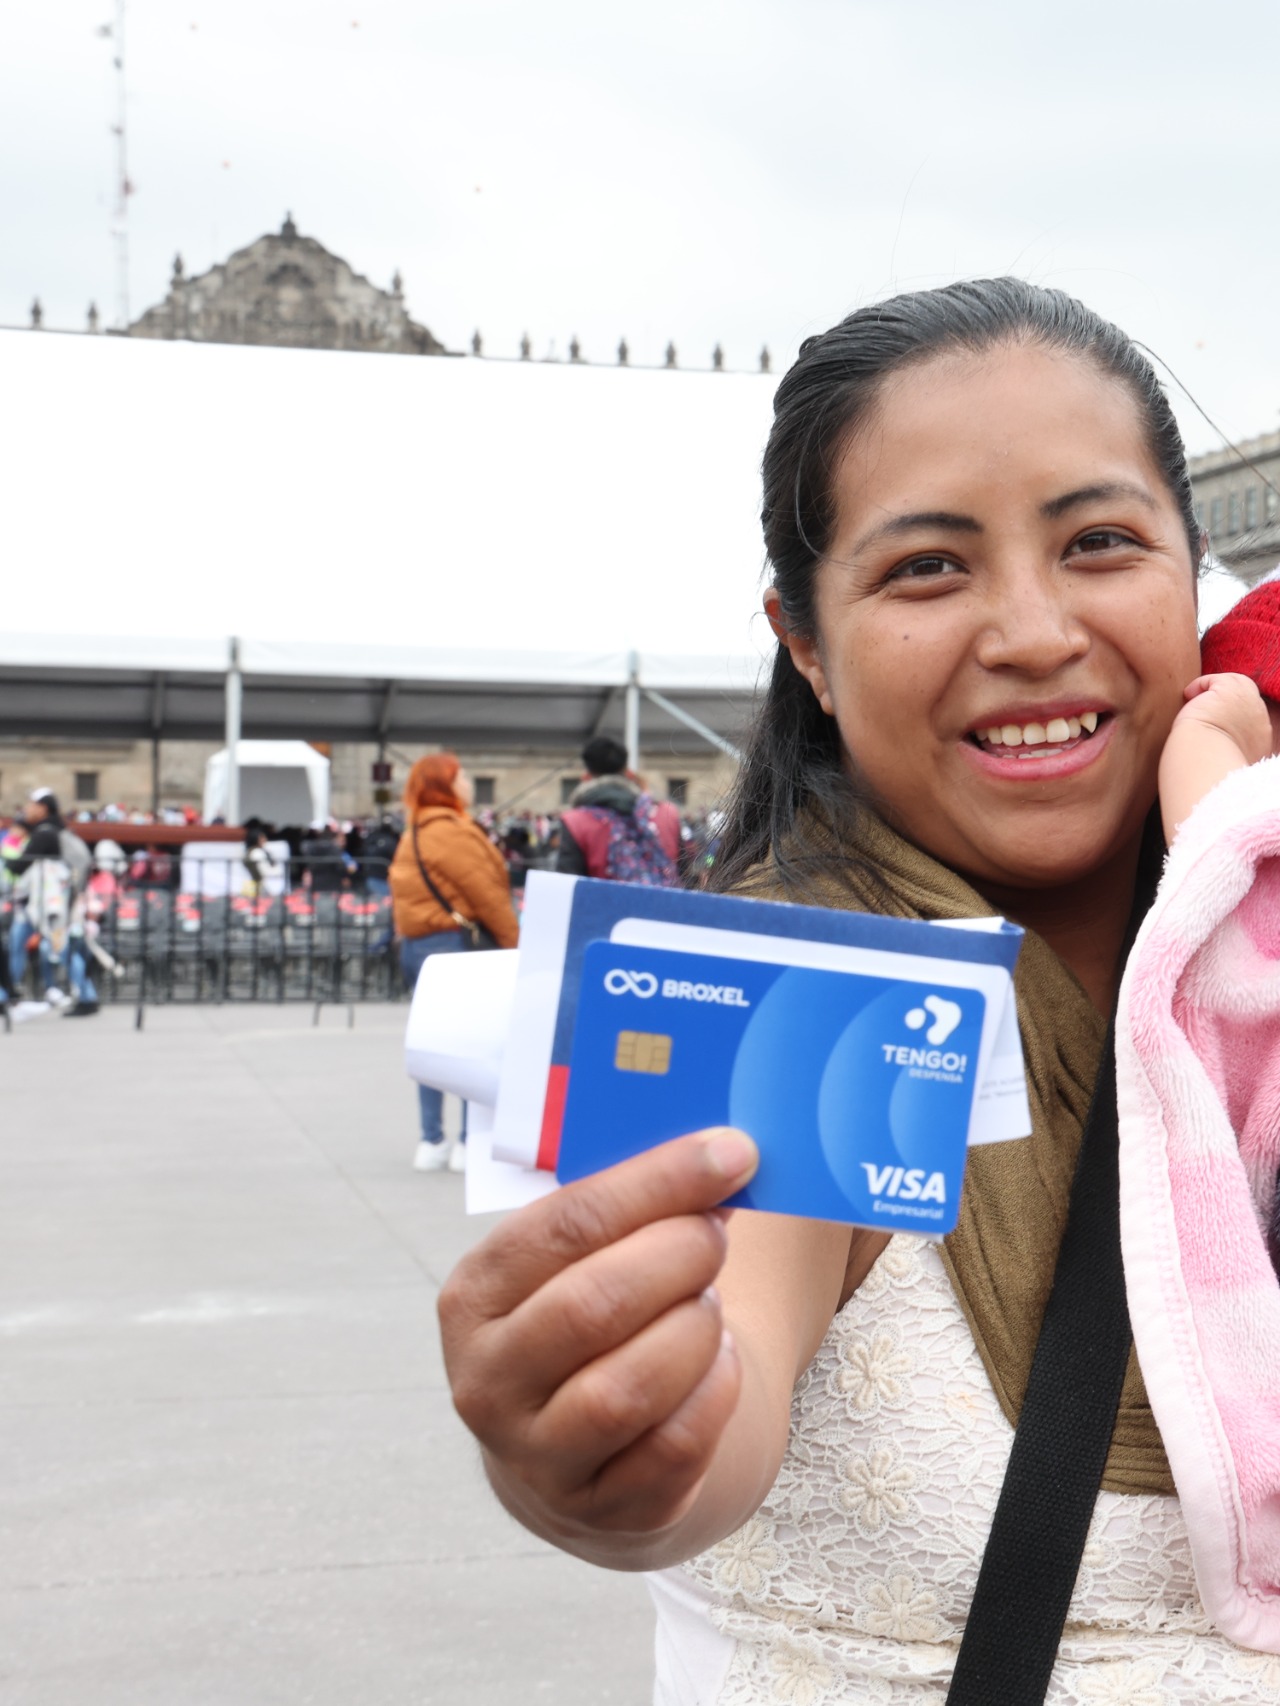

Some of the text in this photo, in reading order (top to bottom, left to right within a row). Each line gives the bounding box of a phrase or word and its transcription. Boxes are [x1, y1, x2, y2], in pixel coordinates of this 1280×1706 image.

[662, 979, 750, 1007] BROXEL
[882, 1044, 967, 1073] TENGO!
[908, 1069, 964, 1083] DESPENSA
[860, 1163, 946, 1203] VISA
[873, 1201, 943, 1220] Empresarial
